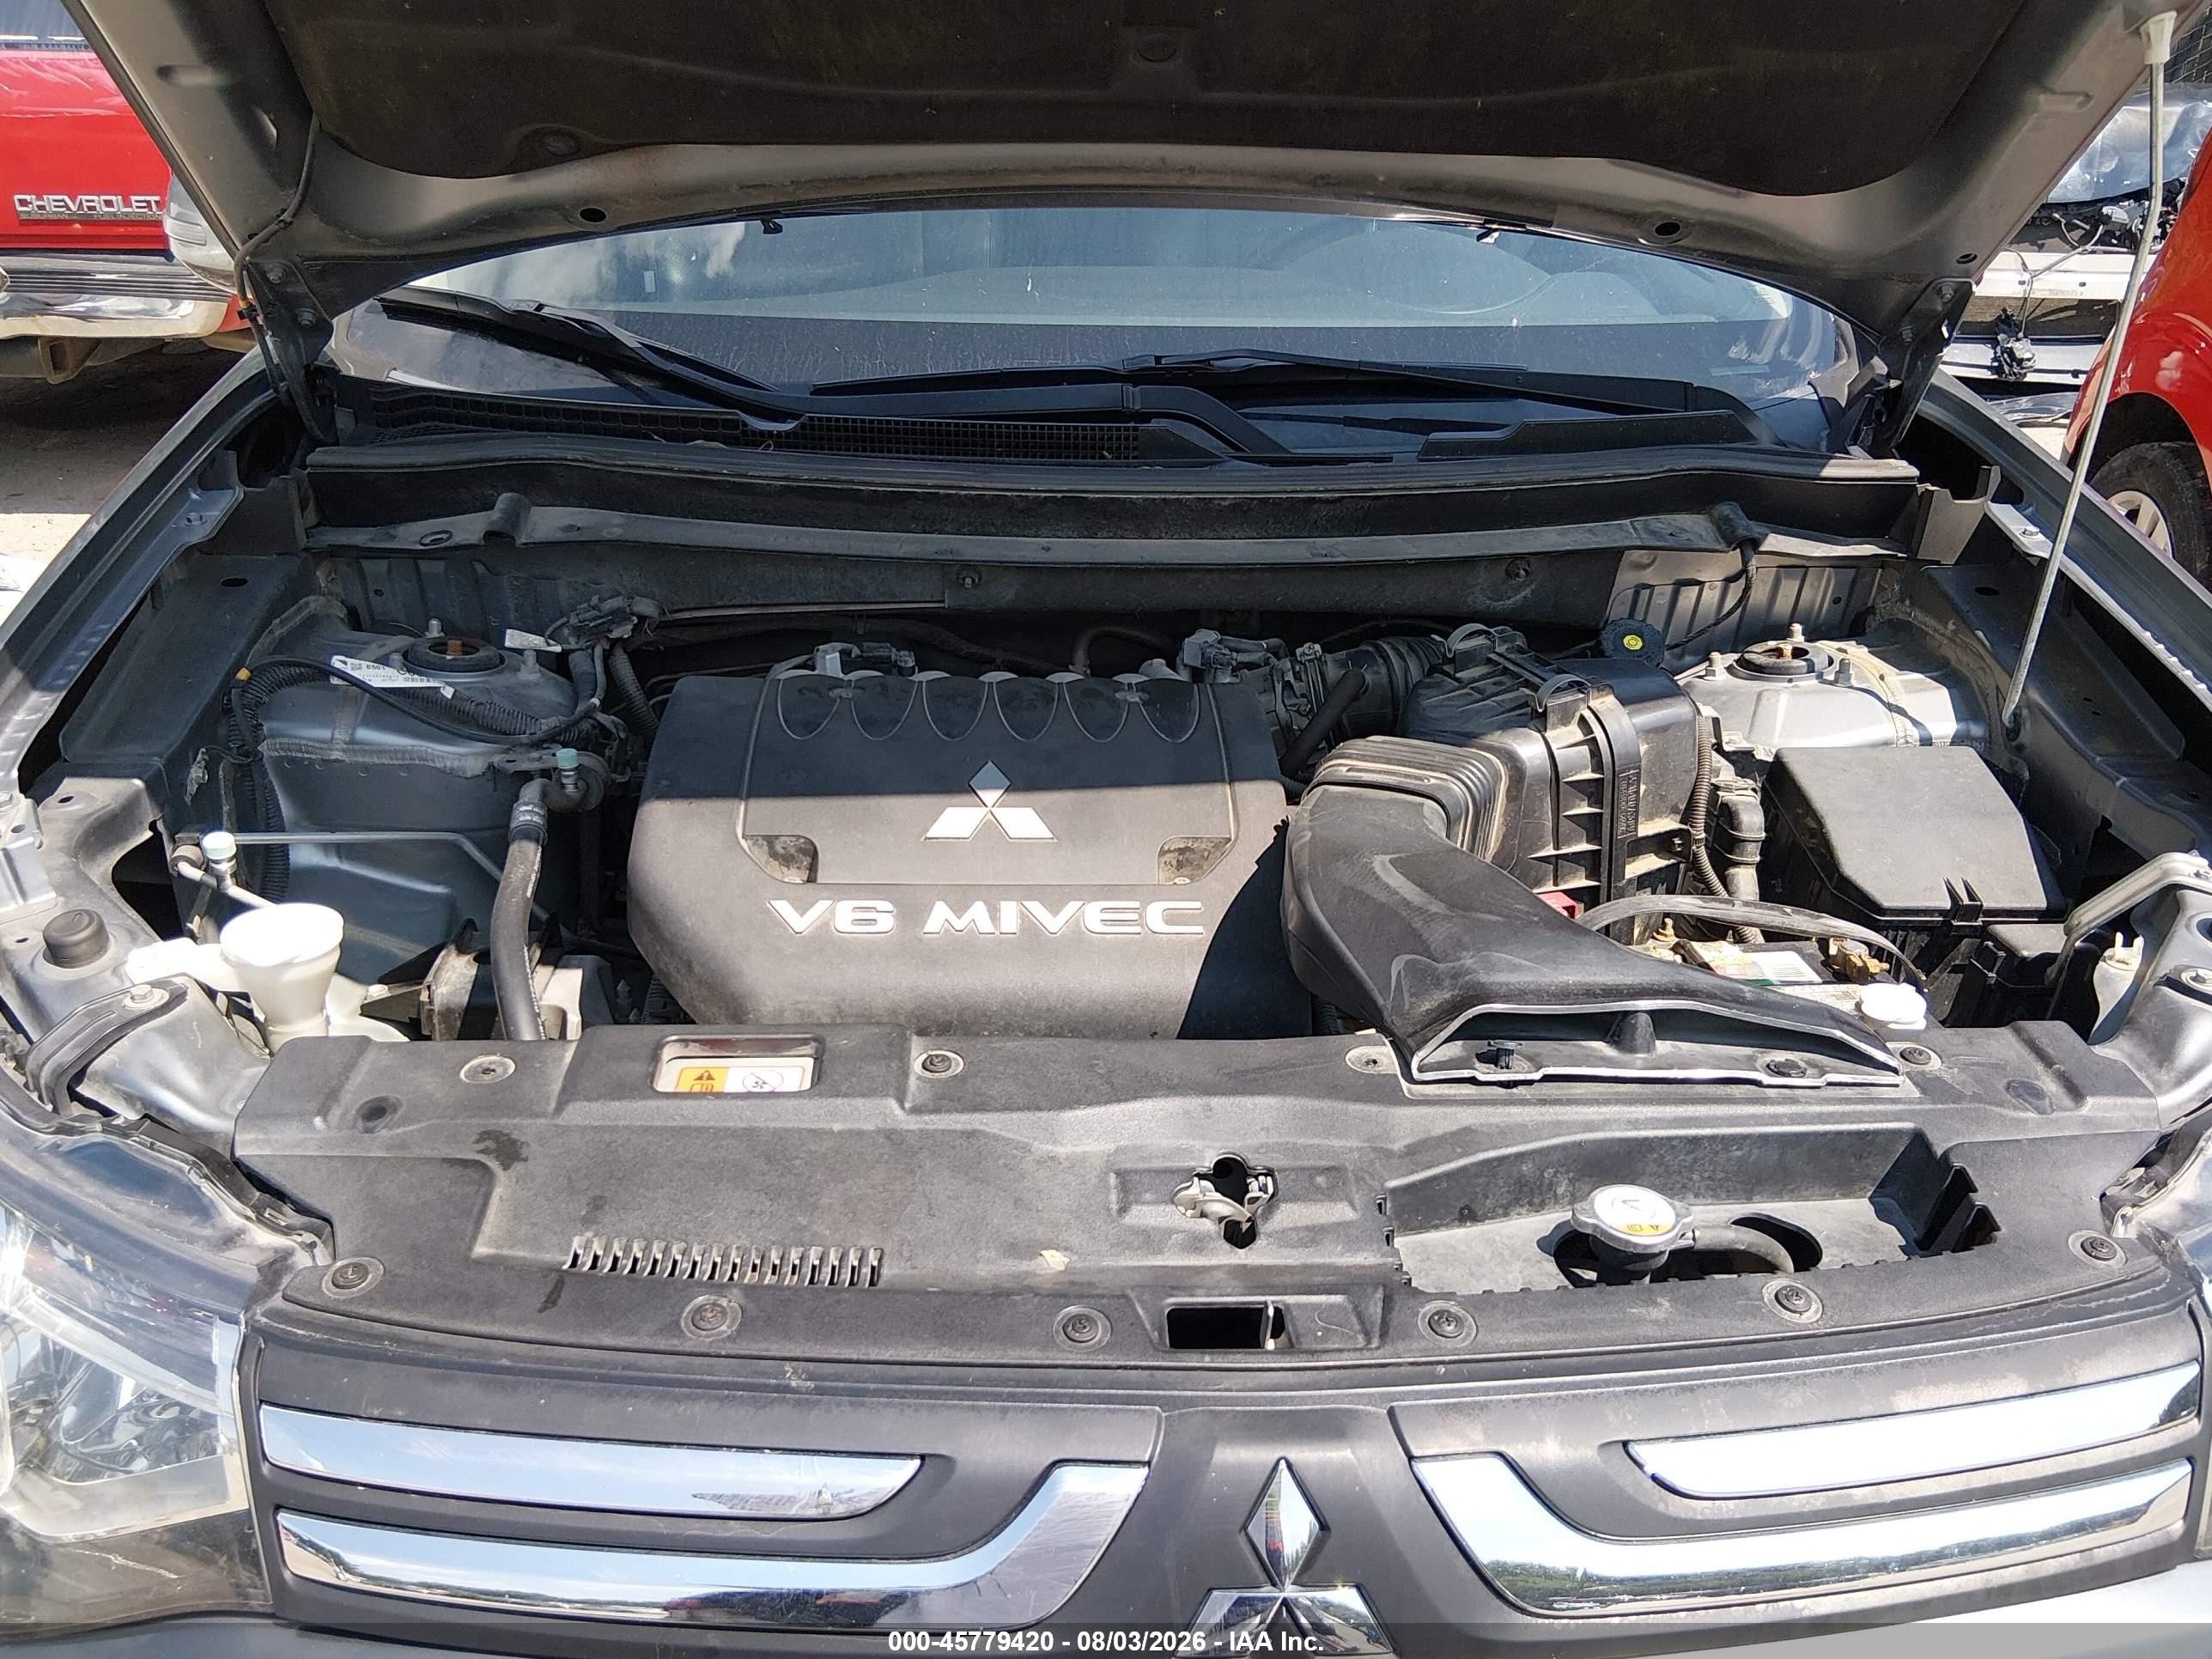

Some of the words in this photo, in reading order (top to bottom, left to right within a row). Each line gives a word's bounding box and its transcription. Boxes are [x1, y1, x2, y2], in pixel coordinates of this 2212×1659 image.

[14, 194, 164, 214] CHEVROLET
[768, 900, 895, 934] V6
[922, 900, 1204, 934] MIVEC
